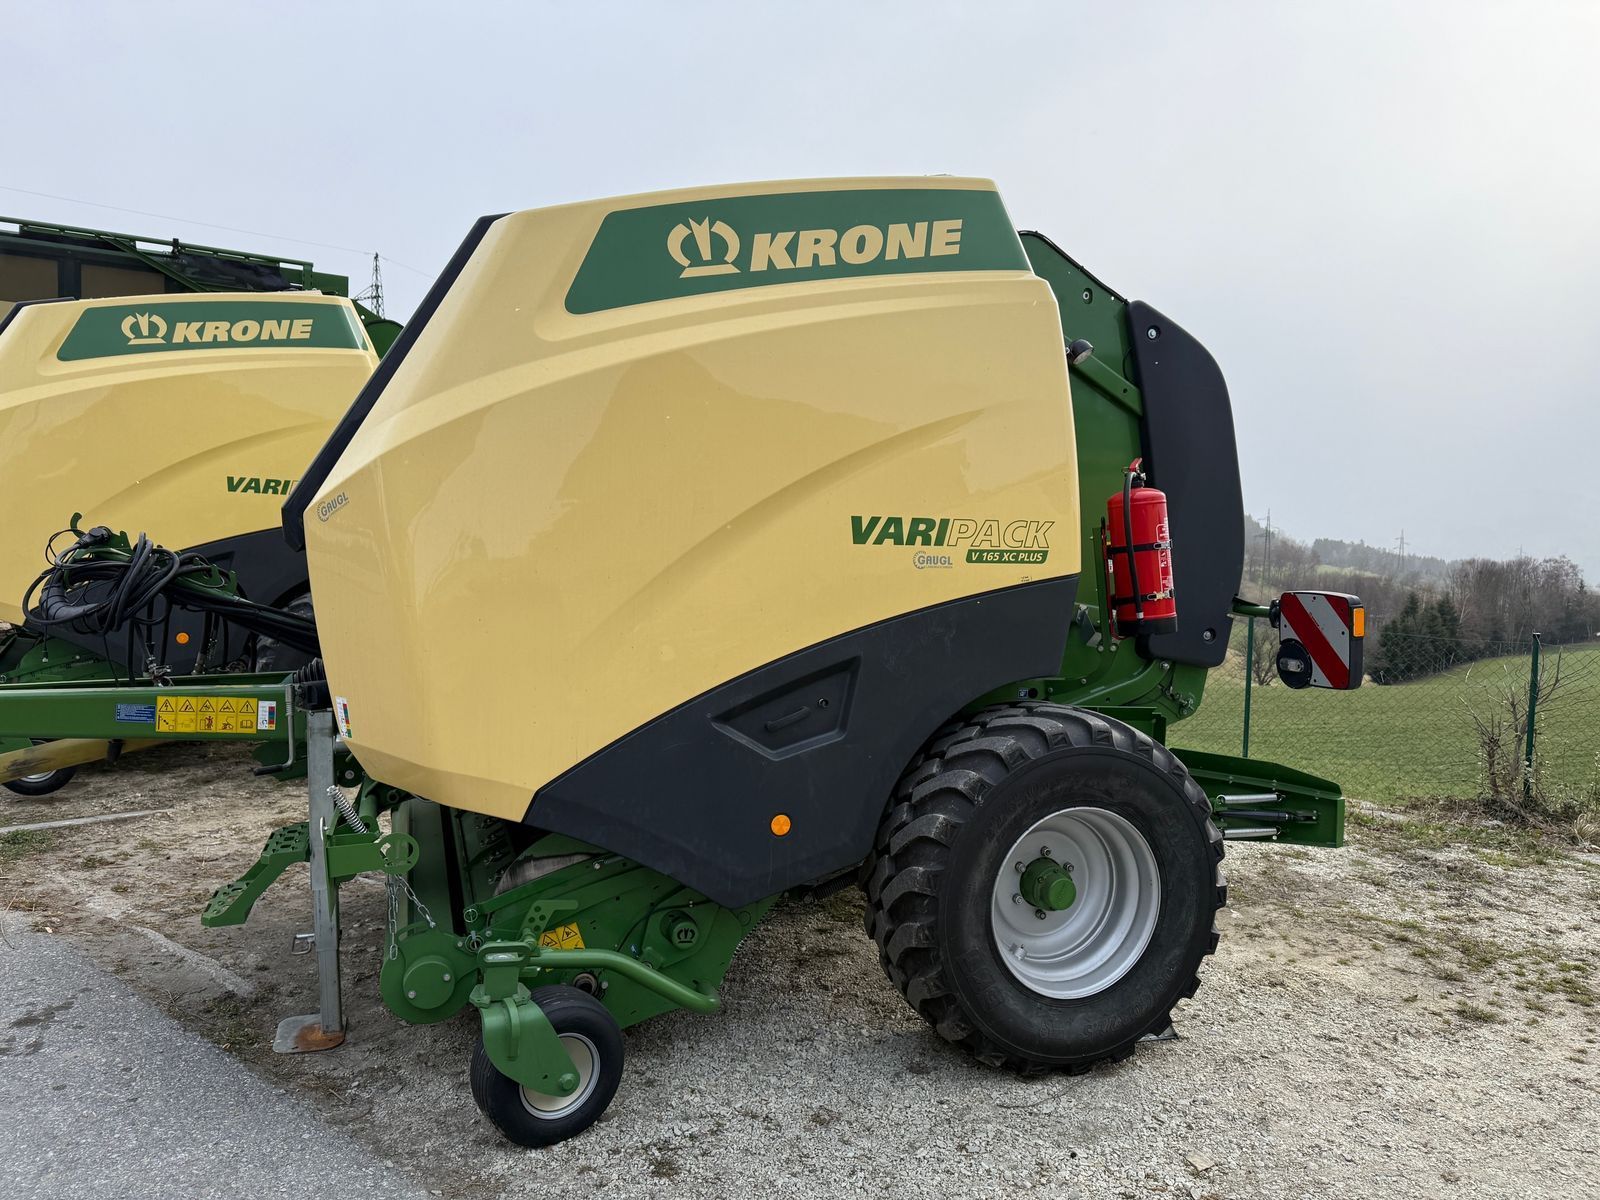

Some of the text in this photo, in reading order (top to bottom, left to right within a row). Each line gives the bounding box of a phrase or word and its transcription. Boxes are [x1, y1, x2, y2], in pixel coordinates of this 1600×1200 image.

[749, 218, 963, 272] KRONE
[172, 319, 314, 343] KRONE
[320, 492, 349, 517] GAUGL
[850, 515, 1056, 549] VARIPACK
[917, 554, 953, 566] GAUGL
[971, 552, 1044, 562] V 165 XC PLUS
